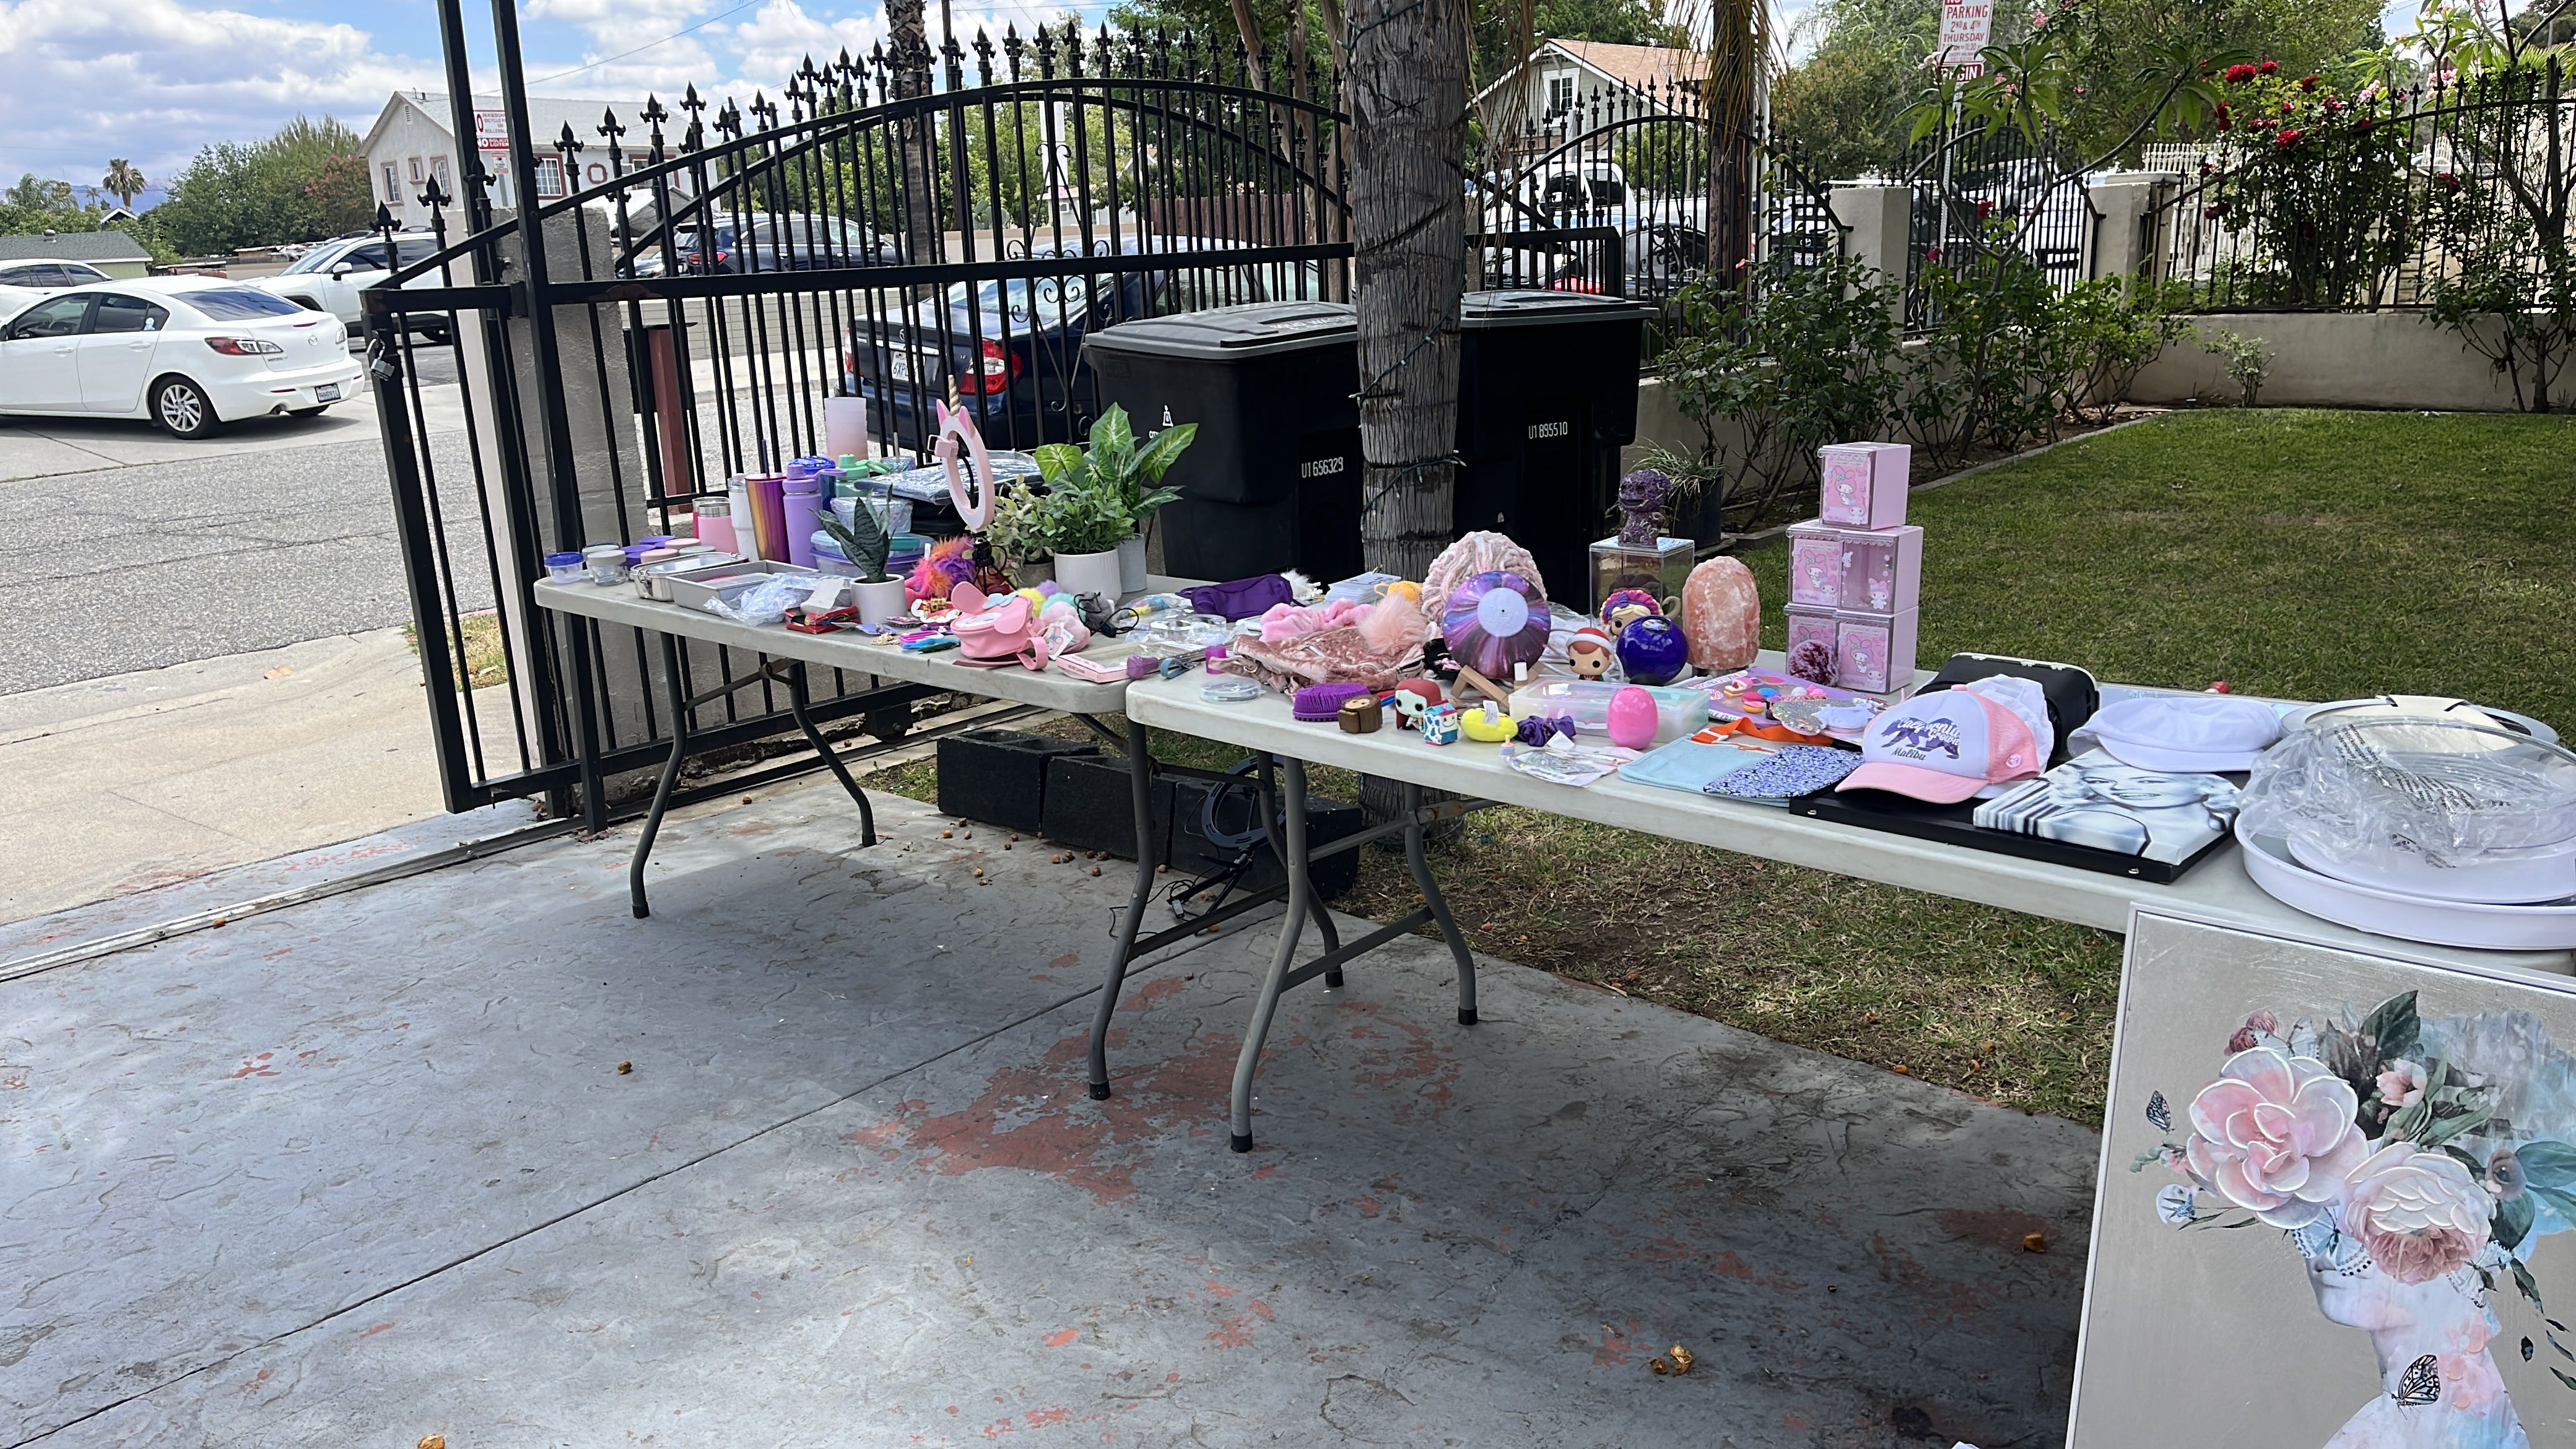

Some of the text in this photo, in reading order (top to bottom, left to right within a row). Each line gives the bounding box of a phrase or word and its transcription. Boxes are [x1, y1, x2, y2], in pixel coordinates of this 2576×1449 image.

[1946, 5, 1989, 19] PARKING
[1943, 33, 1985, 42] THURSDAY
[1539, 421, 1568, 438] 895510
[1313, 456, 1344, 477] 656329
[1926, 728, 1959, 746] Grown
[1891, 747, 1927, 761] Malibu
